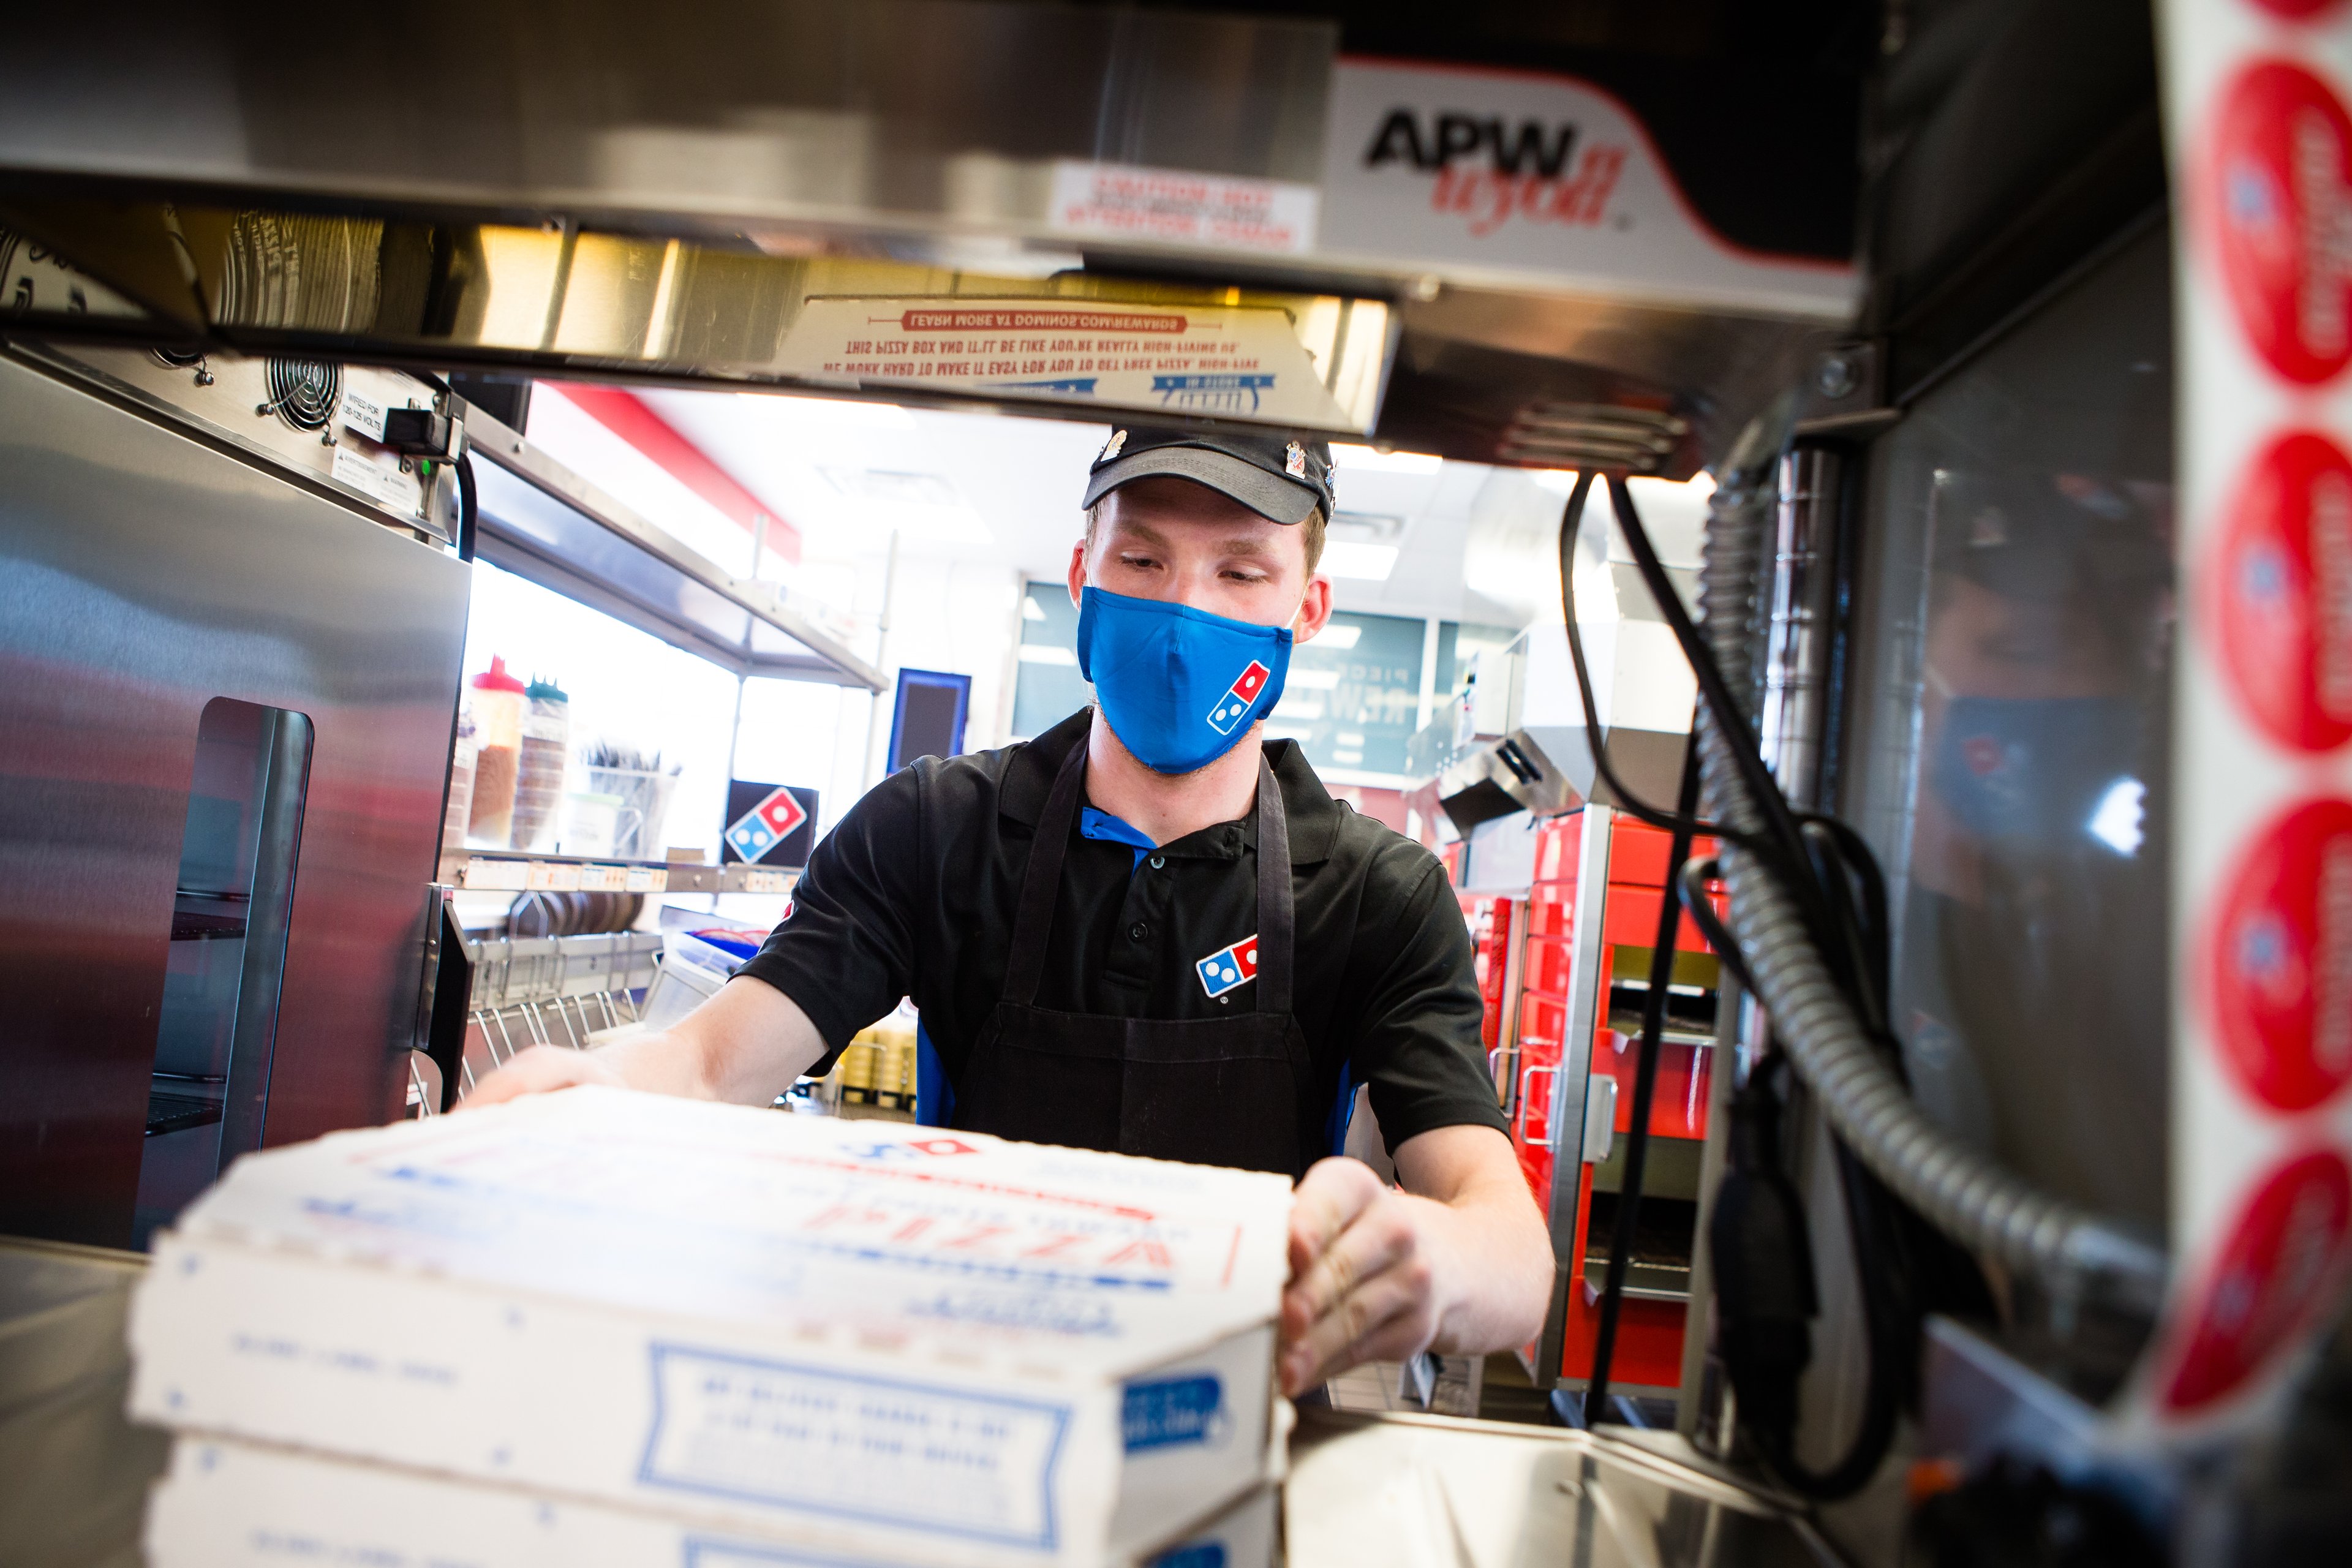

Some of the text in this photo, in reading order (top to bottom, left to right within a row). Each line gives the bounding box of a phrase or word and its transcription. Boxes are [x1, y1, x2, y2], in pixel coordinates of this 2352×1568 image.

[1363, 104, 1579, 176] APW
[348, 392, 379, 417] WIRED FOR
[363, 415, 382, 431] VOLTS
[804, 1205, 1173, 1268] PIZZA
